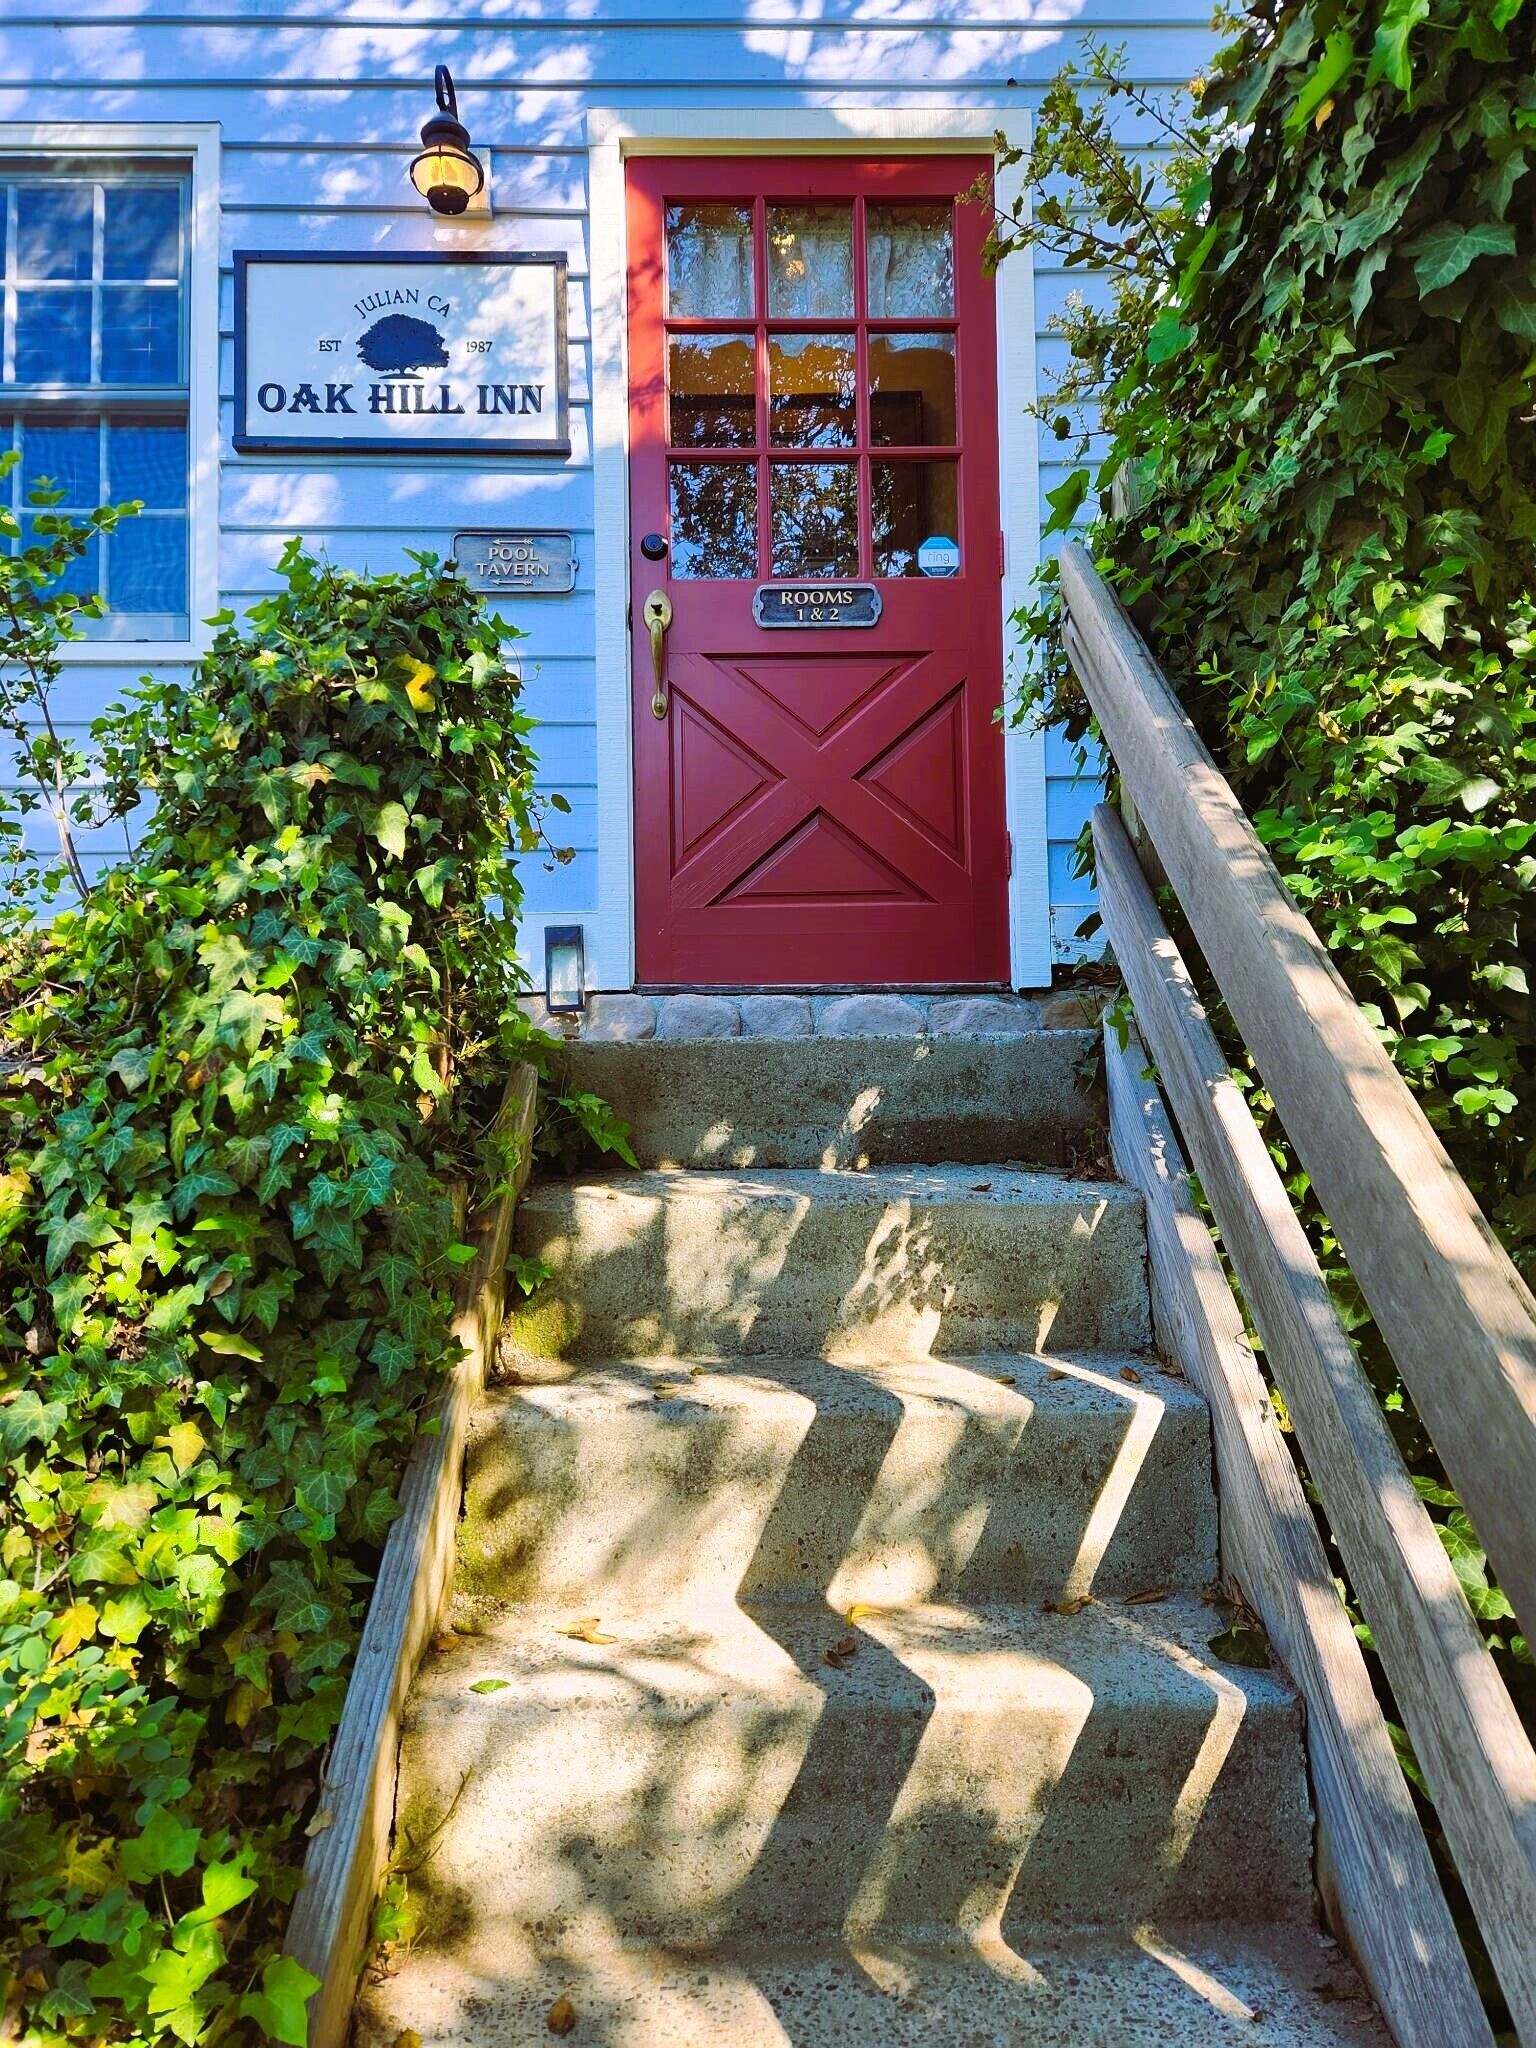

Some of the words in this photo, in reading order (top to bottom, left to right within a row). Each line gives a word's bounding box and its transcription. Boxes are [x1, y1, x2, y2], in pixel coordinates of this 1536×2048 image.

[354, 288, 420, 319] JULIAN
[427, 295, 451, 318] CA
[319, 340, 342, 352] EST
[466, 341, 493, 353] 1987
[257, 382, 357, 414] OAK
[368, 383, 465, 415] HILL
[476, 384, 546, 415] INN
[488, 547, 540, 561] POOL
[927, 551, 950, 565] ring
[475, 562, 550, 576] TAVERN
[781, 590, 853, 605] ROOMS
[796, 608, 804, 621] 1
[810, 607, 824, 621] &
[829, 608, 840, 621] 2
